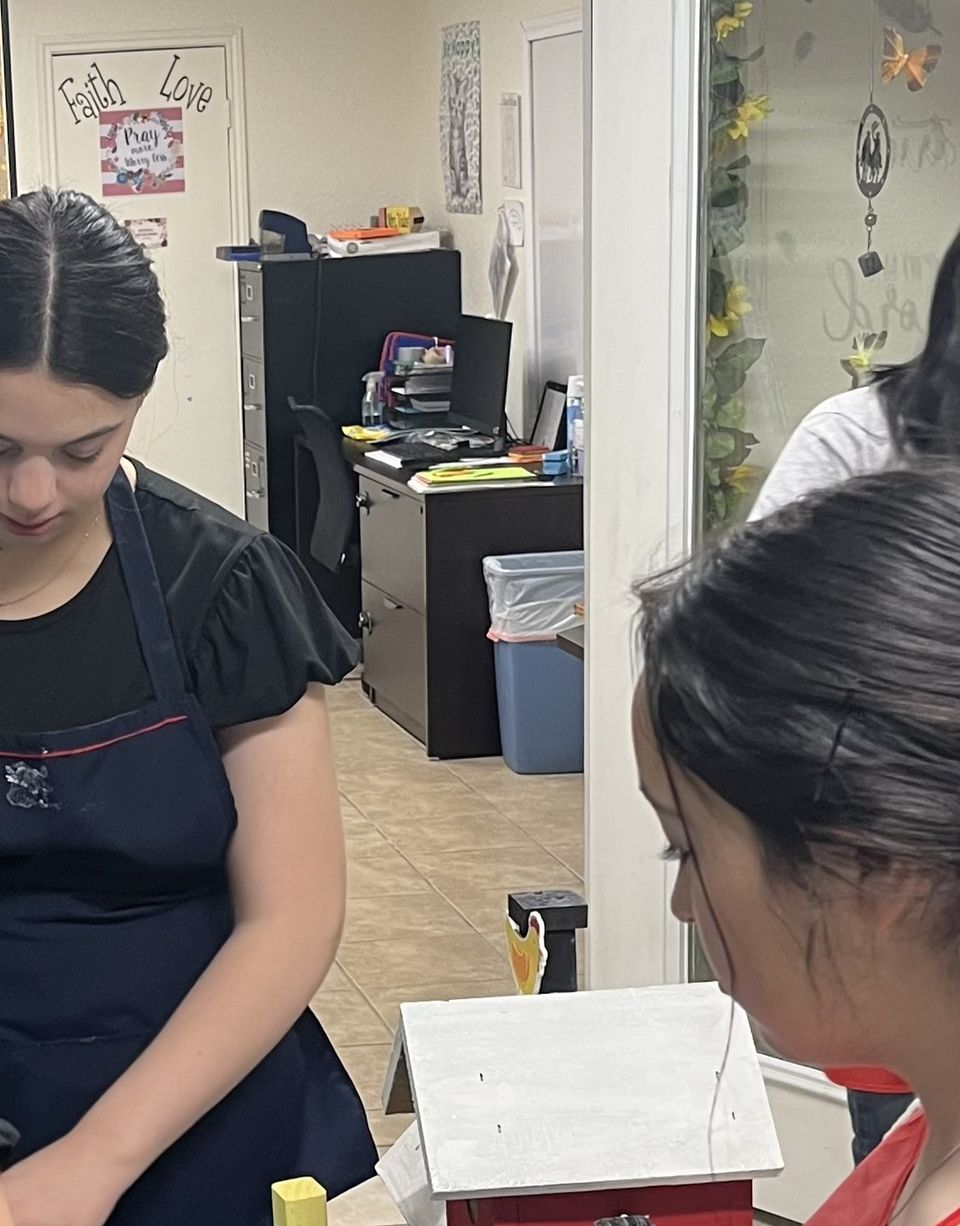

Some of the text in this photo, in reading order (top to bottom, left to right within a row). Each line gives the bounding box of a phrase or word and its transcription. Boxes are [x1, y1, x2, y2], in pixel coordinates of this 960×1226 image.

[58, 54, 213, 125] Faith Love
[124, 127, 160, 148] Pray
